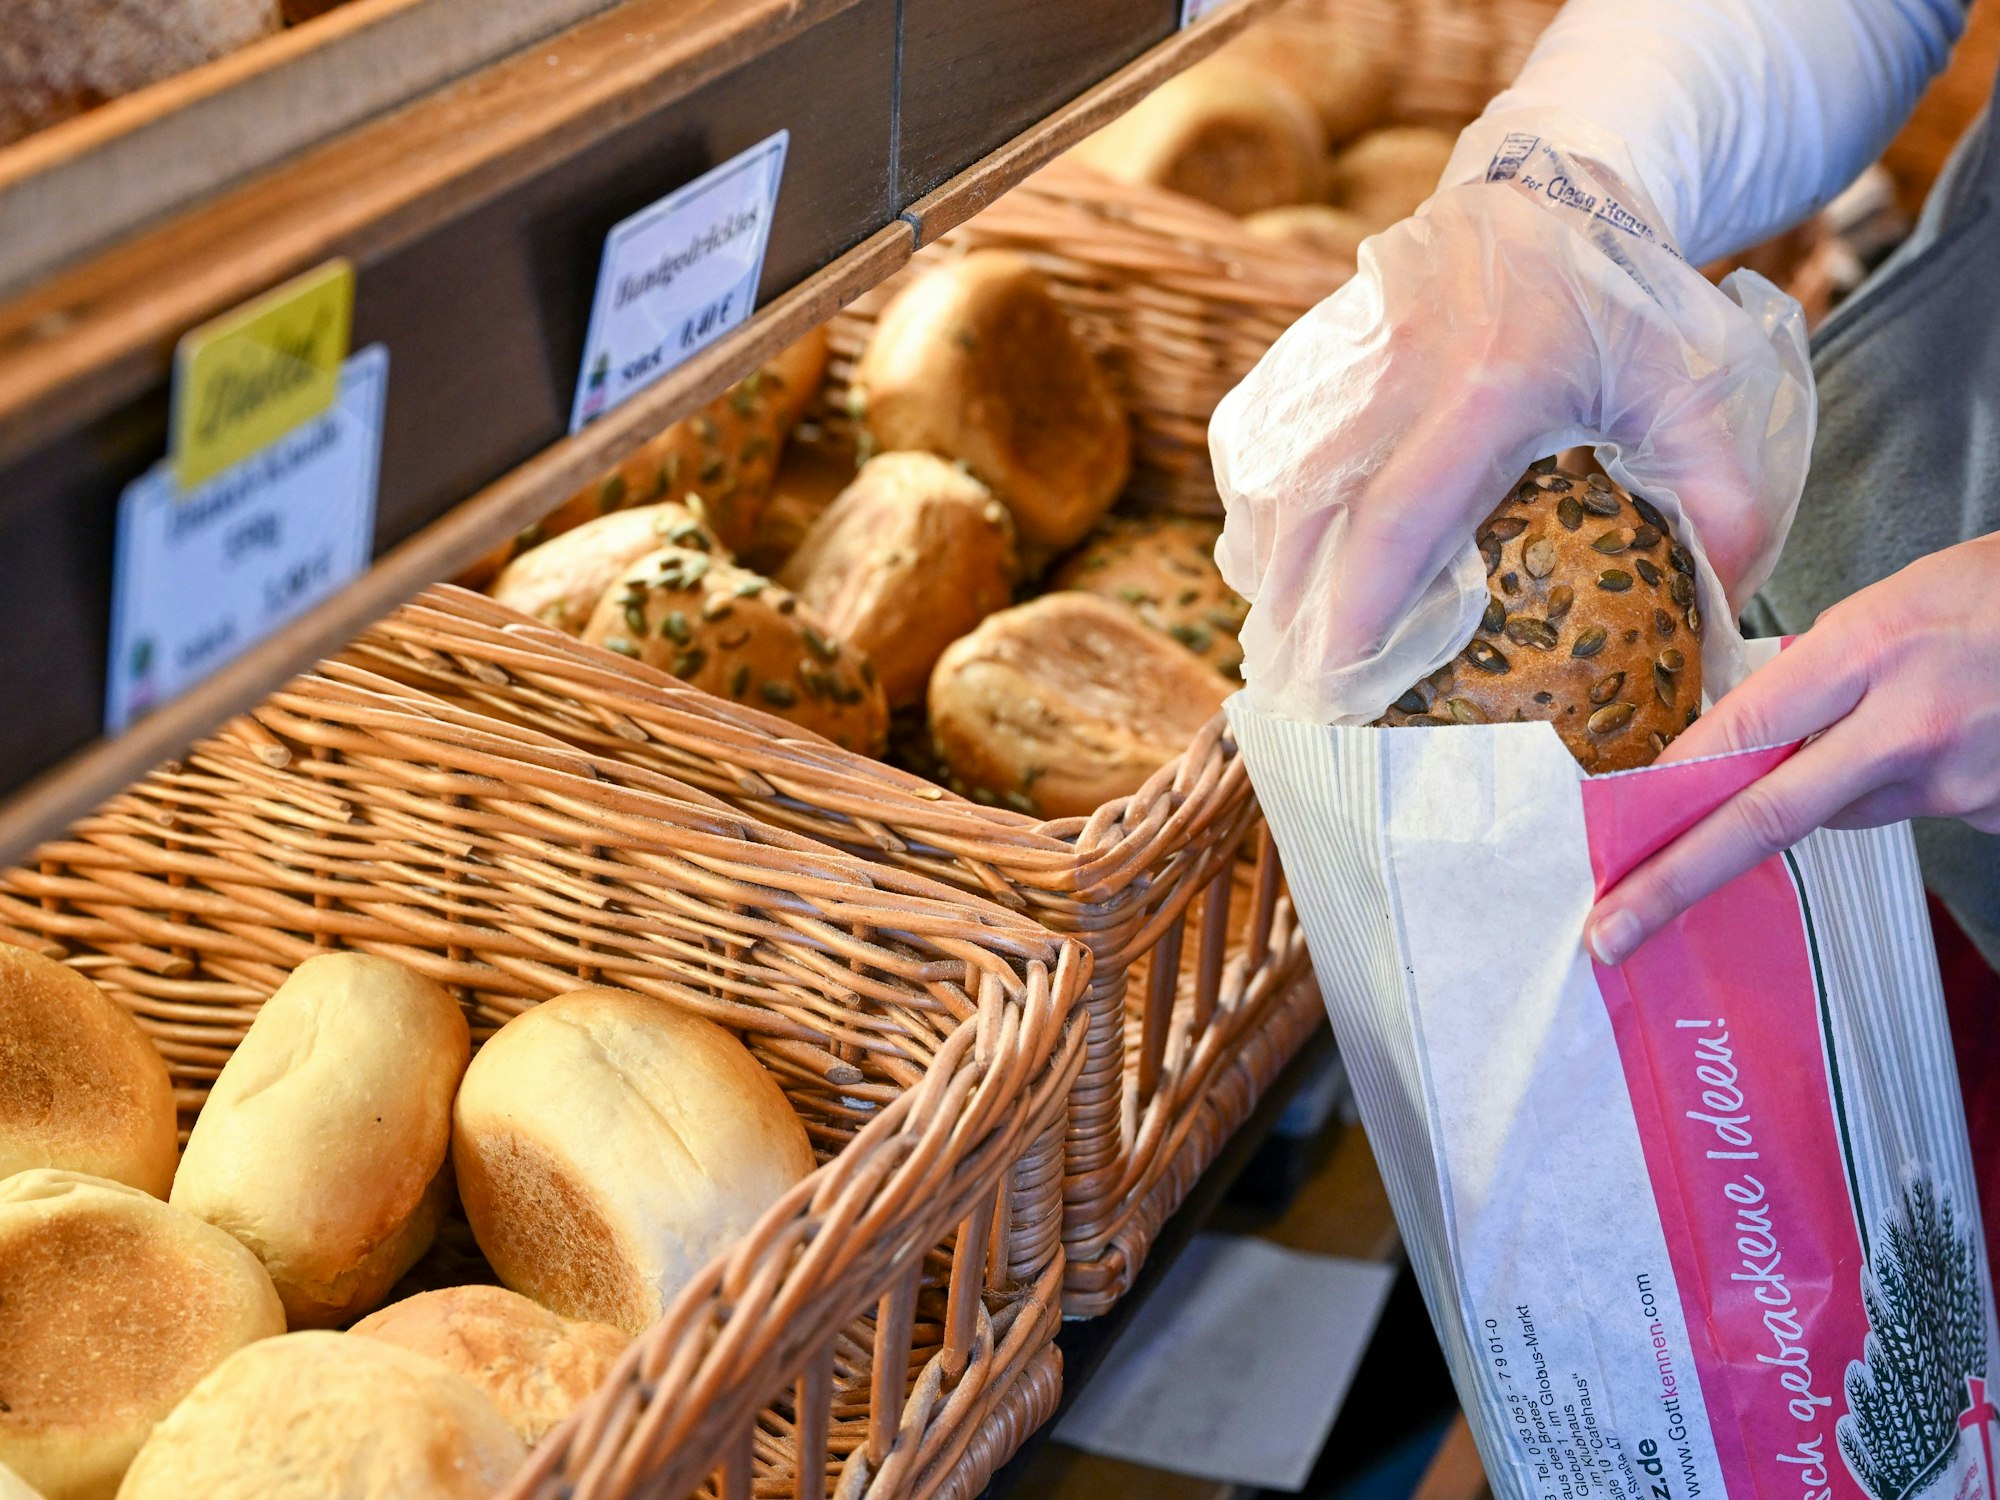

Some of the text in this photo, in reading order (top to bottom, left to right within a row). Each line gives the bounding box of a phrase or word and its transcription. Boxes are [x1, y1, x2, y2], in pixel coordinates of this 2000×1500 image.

[1521, 175, 1544, 191] For
[1675, 1017, 1760, 1159] Ideen!
[1725, 1174, 1832, 1420] gebackene
[1516, 1304, 1554, 1406] Globus-Markt
[1637, 1273, 1701, 1498] www.Gottkennen.com
[1548, 1410, 1562, 1427] im
[1564, 1404, 1604, 1487] im Klubhaus
[1534, 1459, 1551, 1482] Tel.
[1547, 1447, 1564, 1470] des
[1564, 1449, 1589, 1497] Globus
